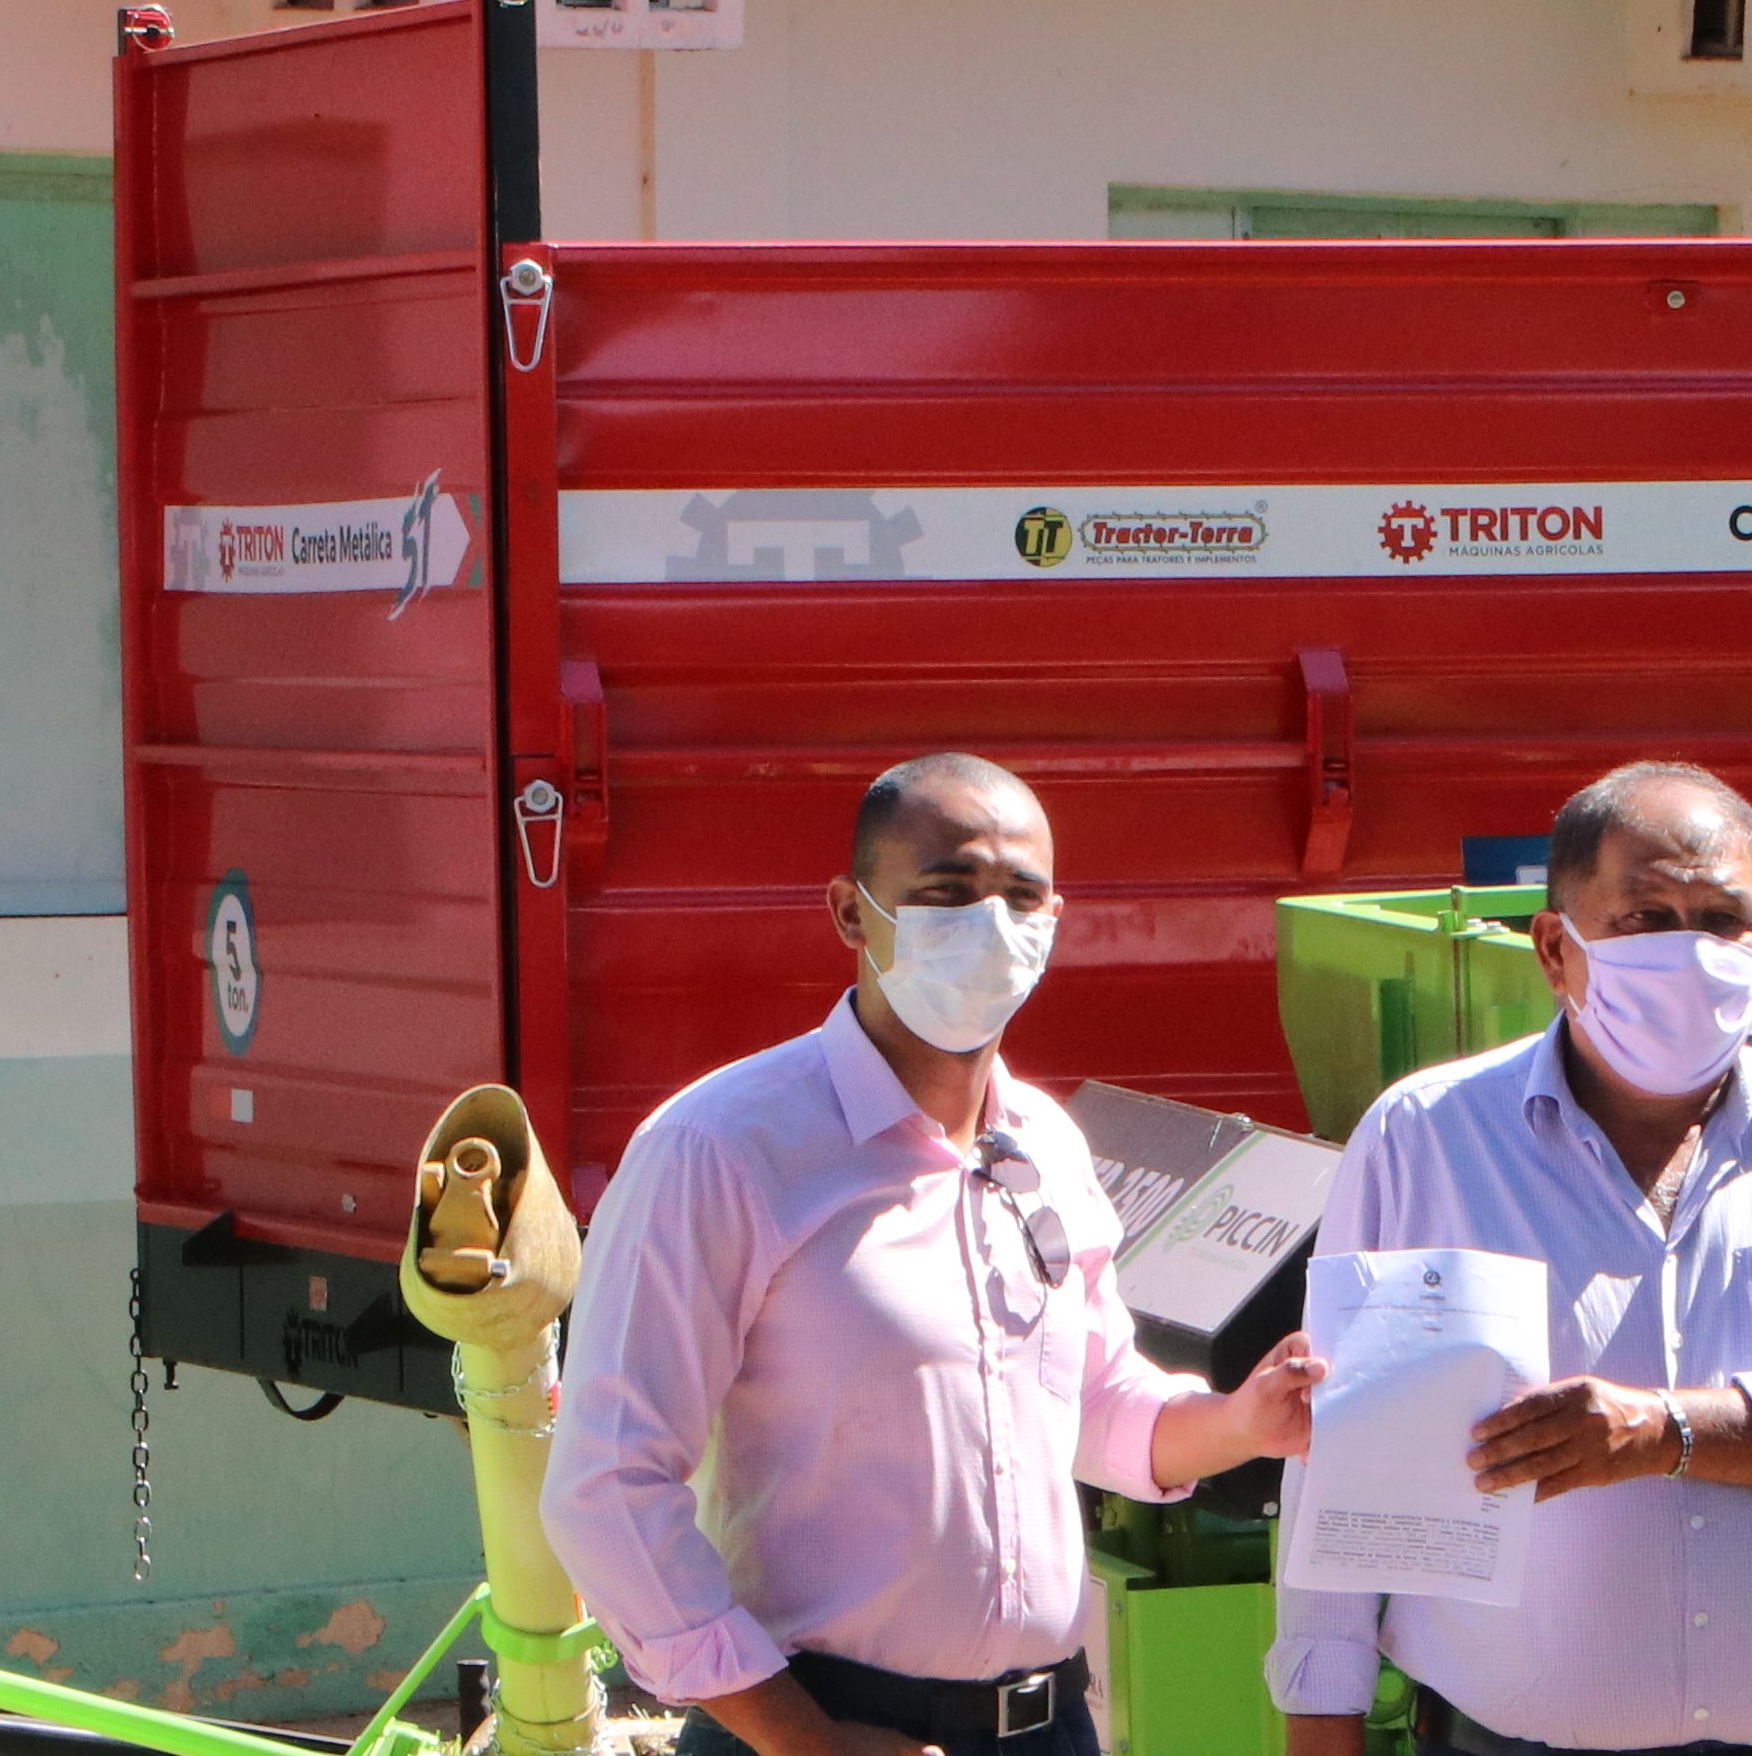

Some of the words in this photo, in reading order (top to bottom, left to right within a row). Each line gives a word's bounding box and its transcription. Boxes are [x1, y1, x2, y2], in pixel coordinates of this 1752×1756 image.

[236, 525, 284, 563] TRITON
[292, 527, 337, 566] Carreta
[339, 520, 393, 564] Metálica
[1441, 506, 1603, 542] TRITON
[1449, 543, 1522, 557] MÁQUINAS
[1525, 541, 1604, 556] AGRÍCOLAS
[226, 919, 242, 982] 5
[1203, 1206, 1299, 1257] PICCIN
